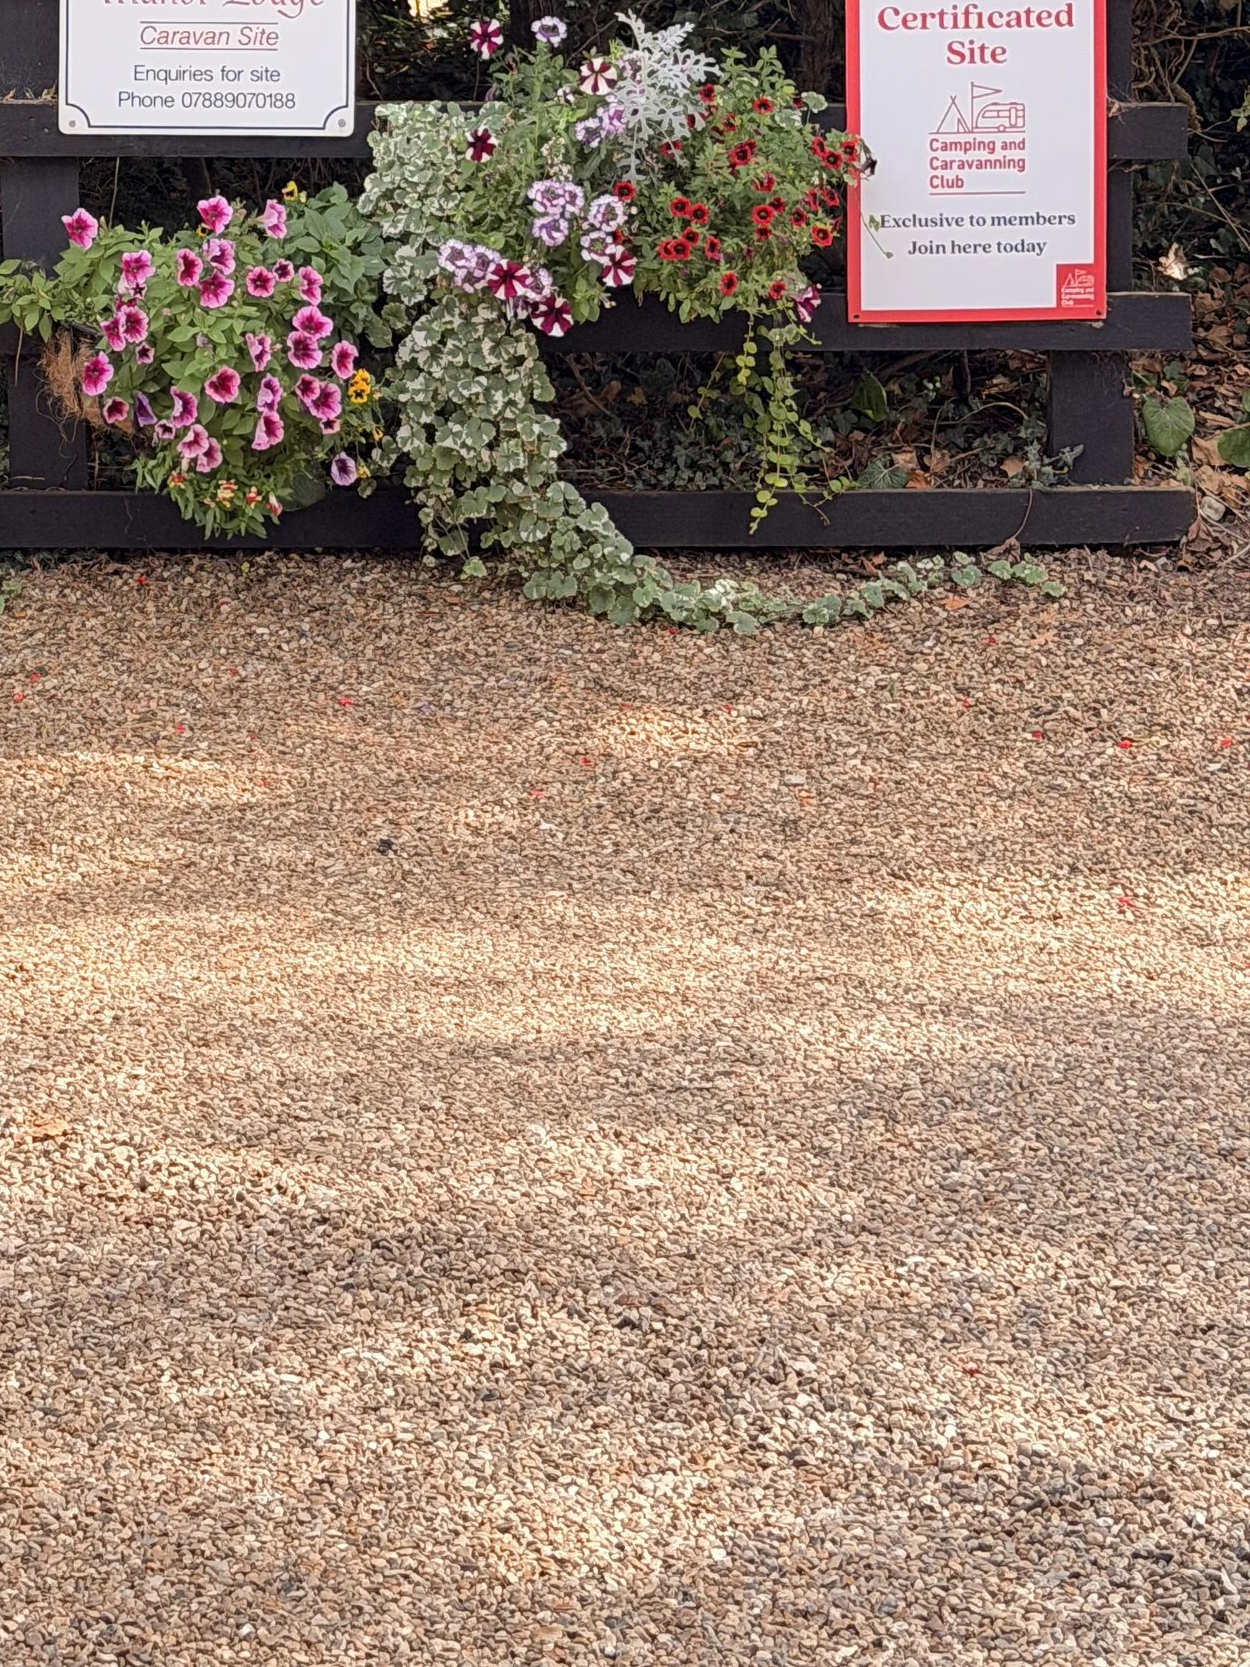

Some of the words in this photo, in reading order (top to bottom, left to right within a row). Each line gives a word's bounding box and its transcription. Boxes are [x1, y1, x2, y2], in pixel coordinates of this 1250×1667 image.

[877, 3, 1075, 31] Certificated
[140, 26, 230, 46] Caravan
[238, 26, 279, 46] Site
[946, 39, 1008, 65] Site
[134, 65, 213, 85] Enquiries
[221, 65, 244, 82] for
[250, 66, 280, 82] site
[118, 91, 175, 109] Phone
[182, 92, 296, 109] 07889070188
[929, 138, 996, 155] Camping
[1000, 137, 1026, 151] and
[929, 156, 1026, 173] Caravanning
[929, 175, 965, 189] Club
[880, 213, 965, 229] Exclusive
[968, 214, 987, 227] to
[990, 211, 1076, 227] members
[908, 240, 946, 256] Join
[950, 240, 993, 254] here
[996, 239, 1047, 256] today
